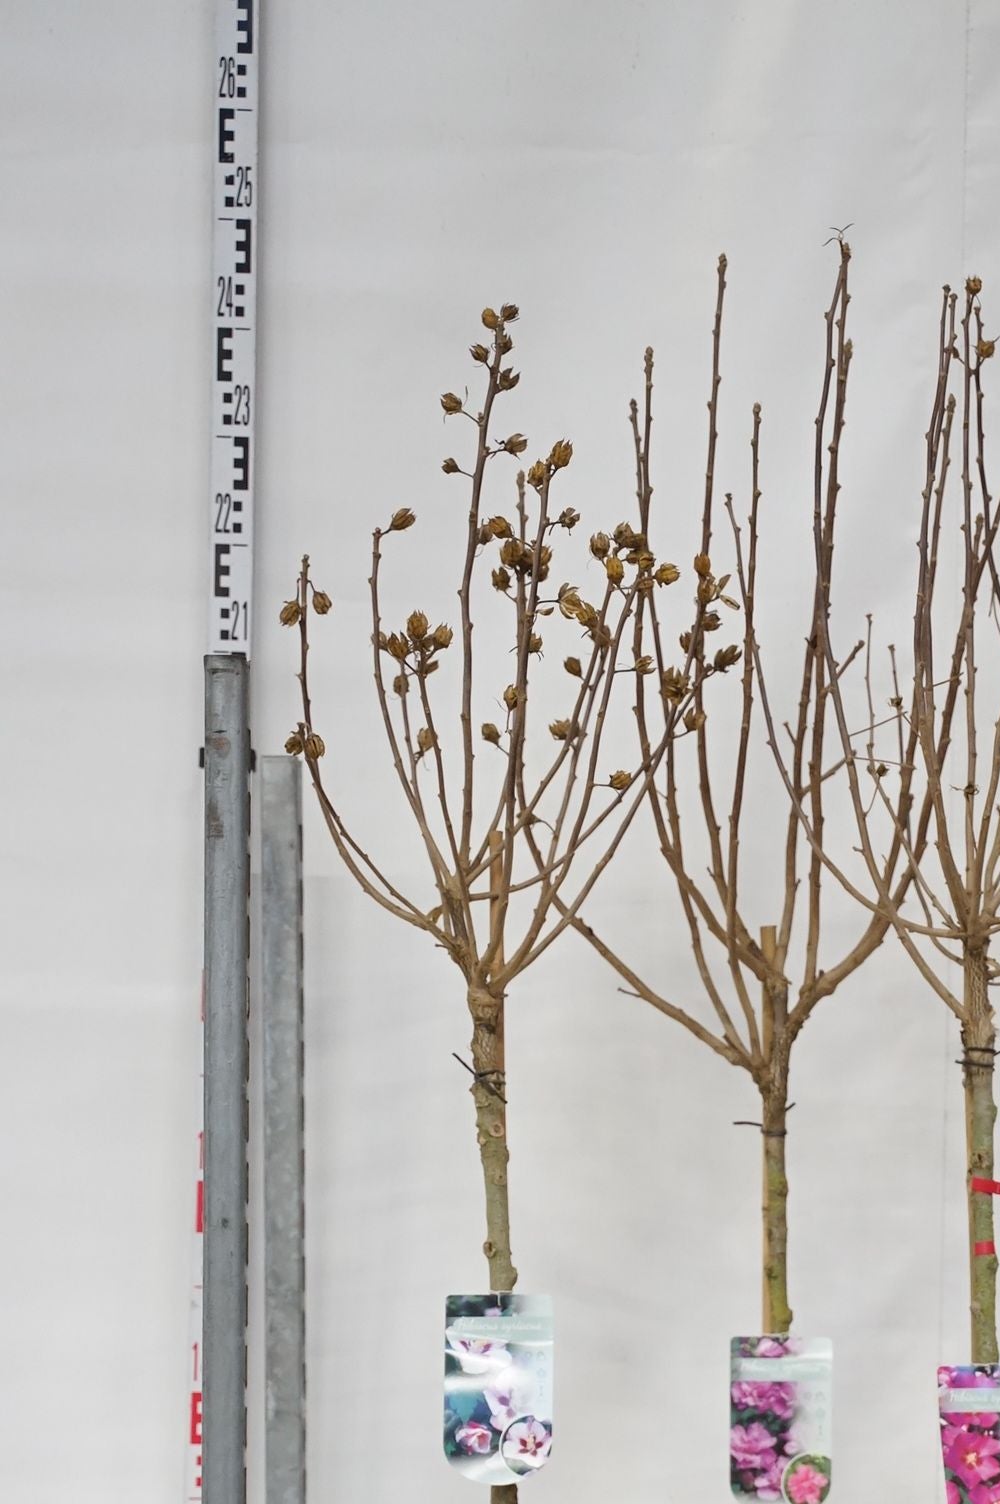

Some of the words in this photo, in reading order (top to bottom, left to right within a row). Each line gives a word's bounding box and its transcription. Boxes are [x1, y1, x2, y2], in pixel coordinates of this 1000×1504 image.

[219, 56, 236, 98] 26
[236, 166, 252, 207] 25
[217, 276, 233, 317] 24
[234, 385, 250, 425] 23
[215, 493, 231, 533] 22
[232, 601, 248, 640] 21
